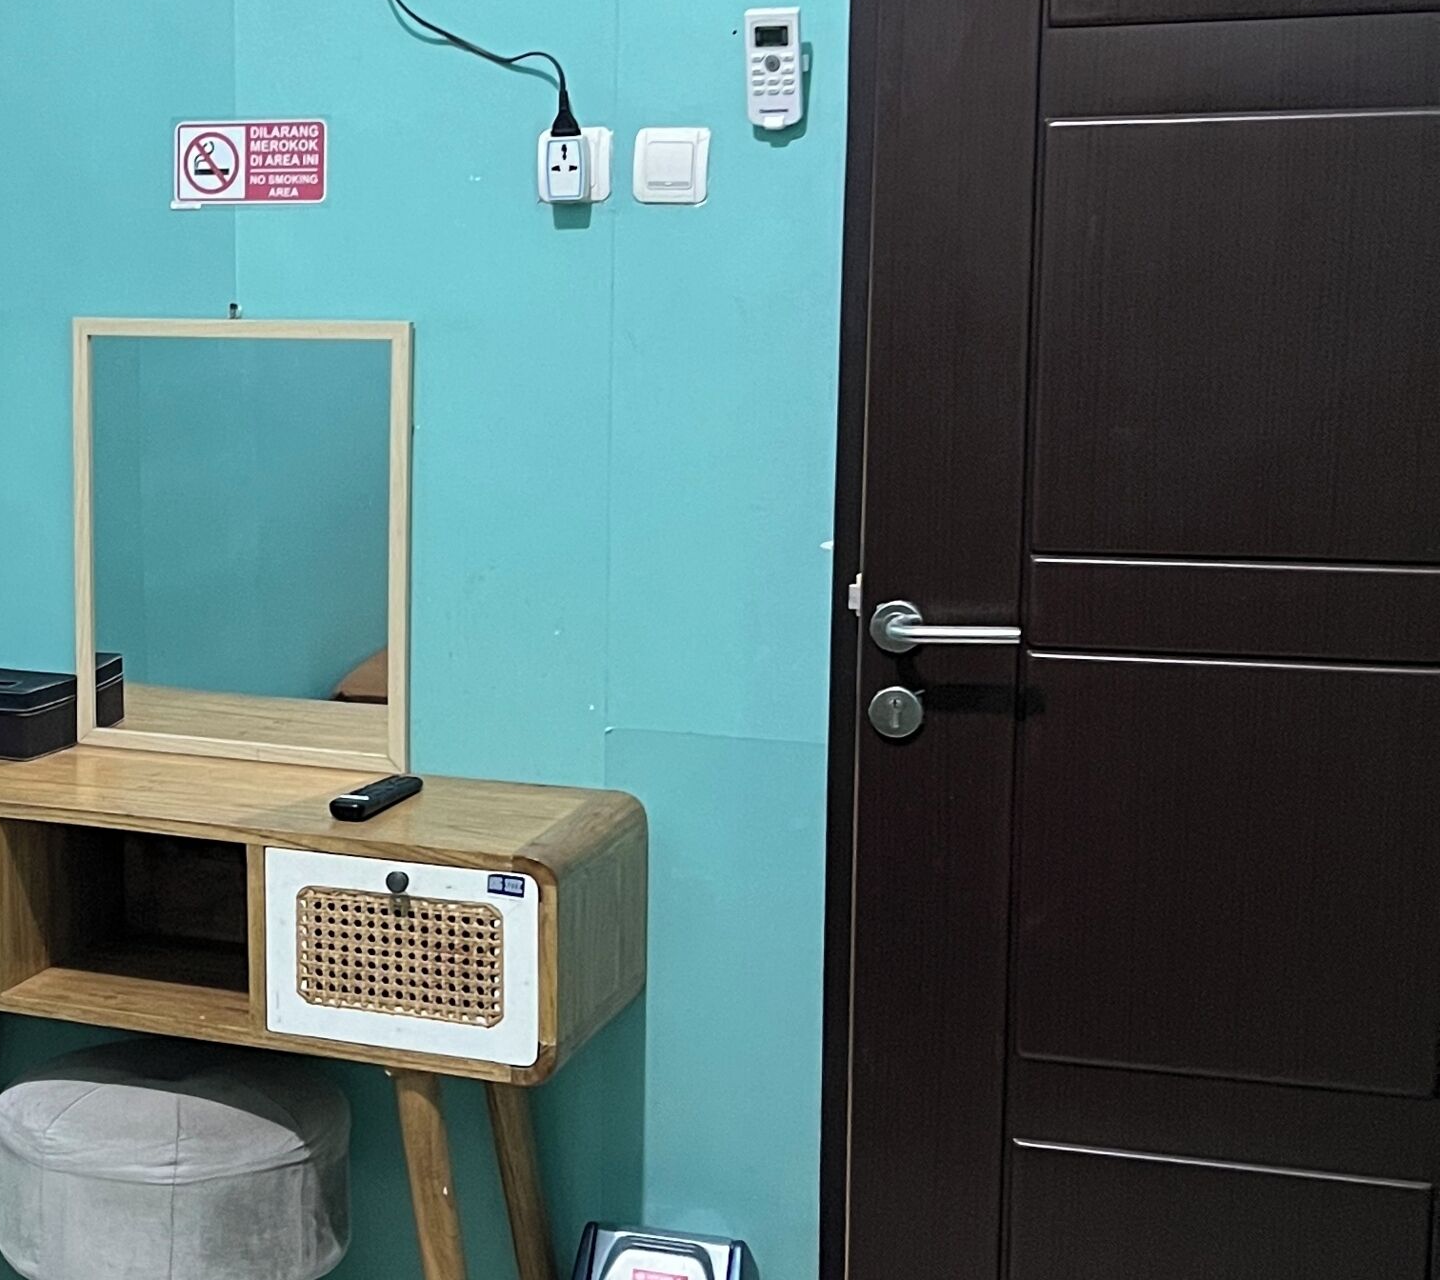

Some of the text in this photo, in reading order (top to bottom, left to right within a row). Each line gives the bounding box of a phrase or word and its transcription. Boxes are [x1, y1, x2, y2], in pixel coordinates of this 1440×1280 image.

[250, 125, 320, 139] DILARANG
[250, 139, 318, 153] MEROKOK
[250, 153, 319, 167] DI AREA INI
[250, 174, 319, 186] NO SMOKING
[268, 187, 299, 198] AREA
